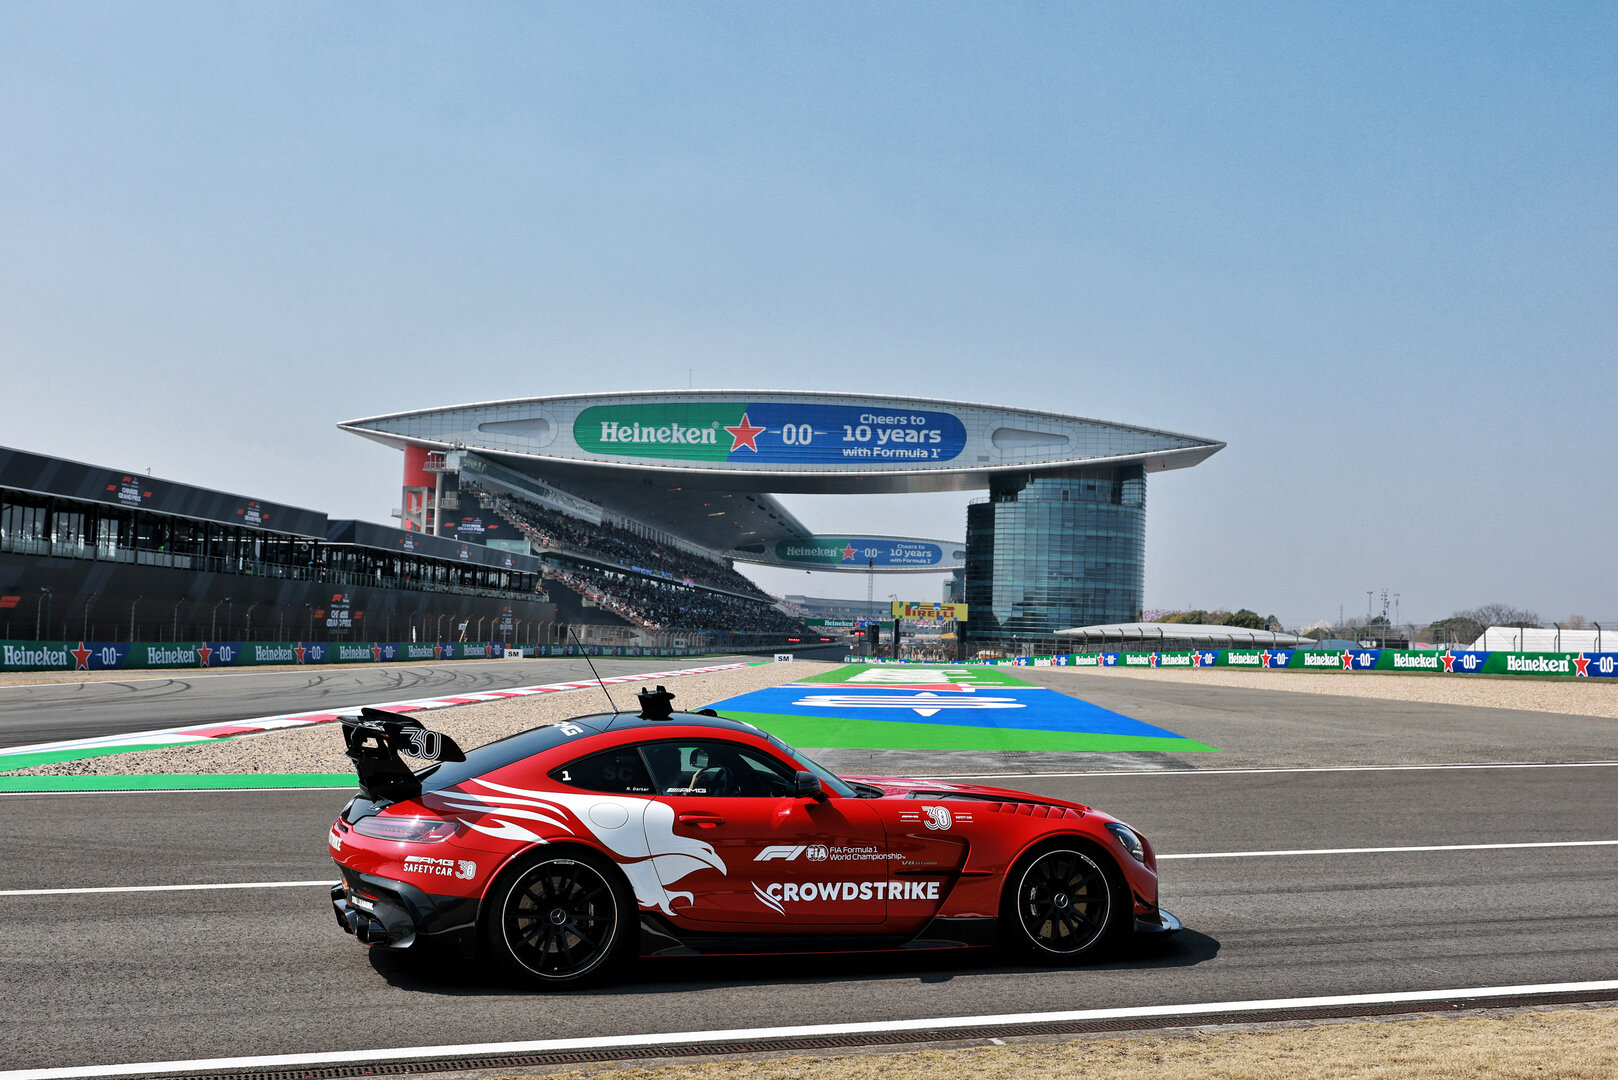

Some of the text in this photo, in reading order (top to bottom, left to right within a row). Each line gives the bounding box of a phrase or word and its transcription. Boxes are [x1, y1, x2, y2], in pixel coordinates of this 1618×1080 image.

[860, 414, 925, 425] Cheers to
[600, 422, 812, 446] Heineken 0.0
[842, 425, 941, 445] 10 years
[842, 447, 871, 457] with
[873, 447, 928, 458] Formula
[786, 546, 837, 557] Heineken
[890, 549, 932, 558] 10 years
[905, 605, 954, 617] PIRELLI
[3, 646, 116, 665] Heineken 0.0
[147, 646, 231, 664] Heineken 0.0
[256, 646, 293, 661] Heineken
[340, 646, 370, 660] Heineken
[1161, 654, 1190, 665] Heineken
[1228, 653, 1259, 664] Heineken
[1304, 653, 1339, 666] Heineken
[1394, 654, 1476, 669] Heineken 0.0
[1507, 656, 1614, 673] Heineken 0.0
[400, 727, 442, 760] 30
[562, 771, 571, 781] 1
[921, 806, 952, 830] 30
[807, 846, 828, 859] FIA
[830, 853, 902, 861] World Championship
[418, 857, 455, 867] AMG
[403, 863, 453, 877] SAFETY CAR
[455, 860, 477, 880] 30
[766, 882, 940, 901] CROWDSTRIKE
